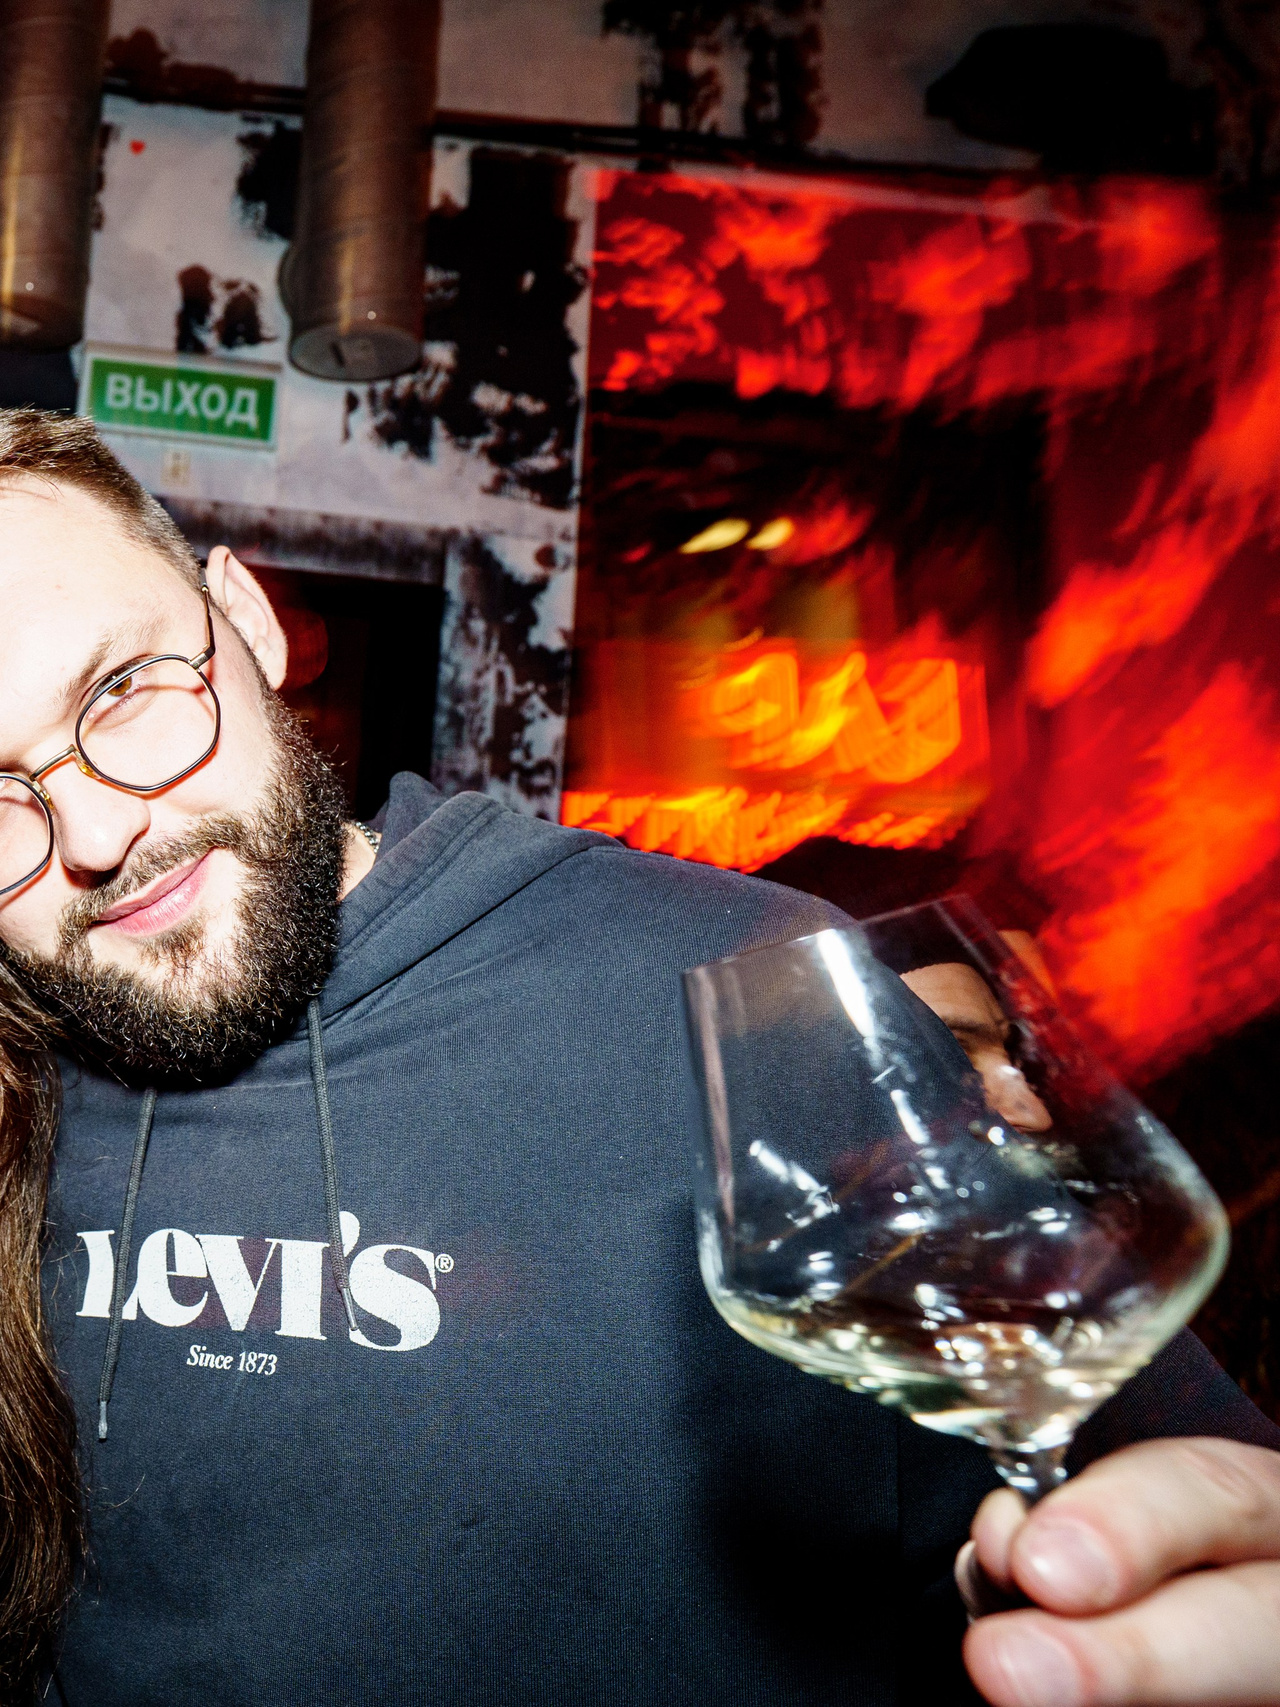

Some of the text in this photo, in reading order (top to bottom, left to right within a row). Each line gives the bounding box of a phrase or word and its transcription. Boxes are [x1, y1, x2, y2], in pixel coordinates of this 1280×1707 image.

[106, 373, 259, 430] ВЫХОД
[186, 1344, 278, 1376] Since 1873
